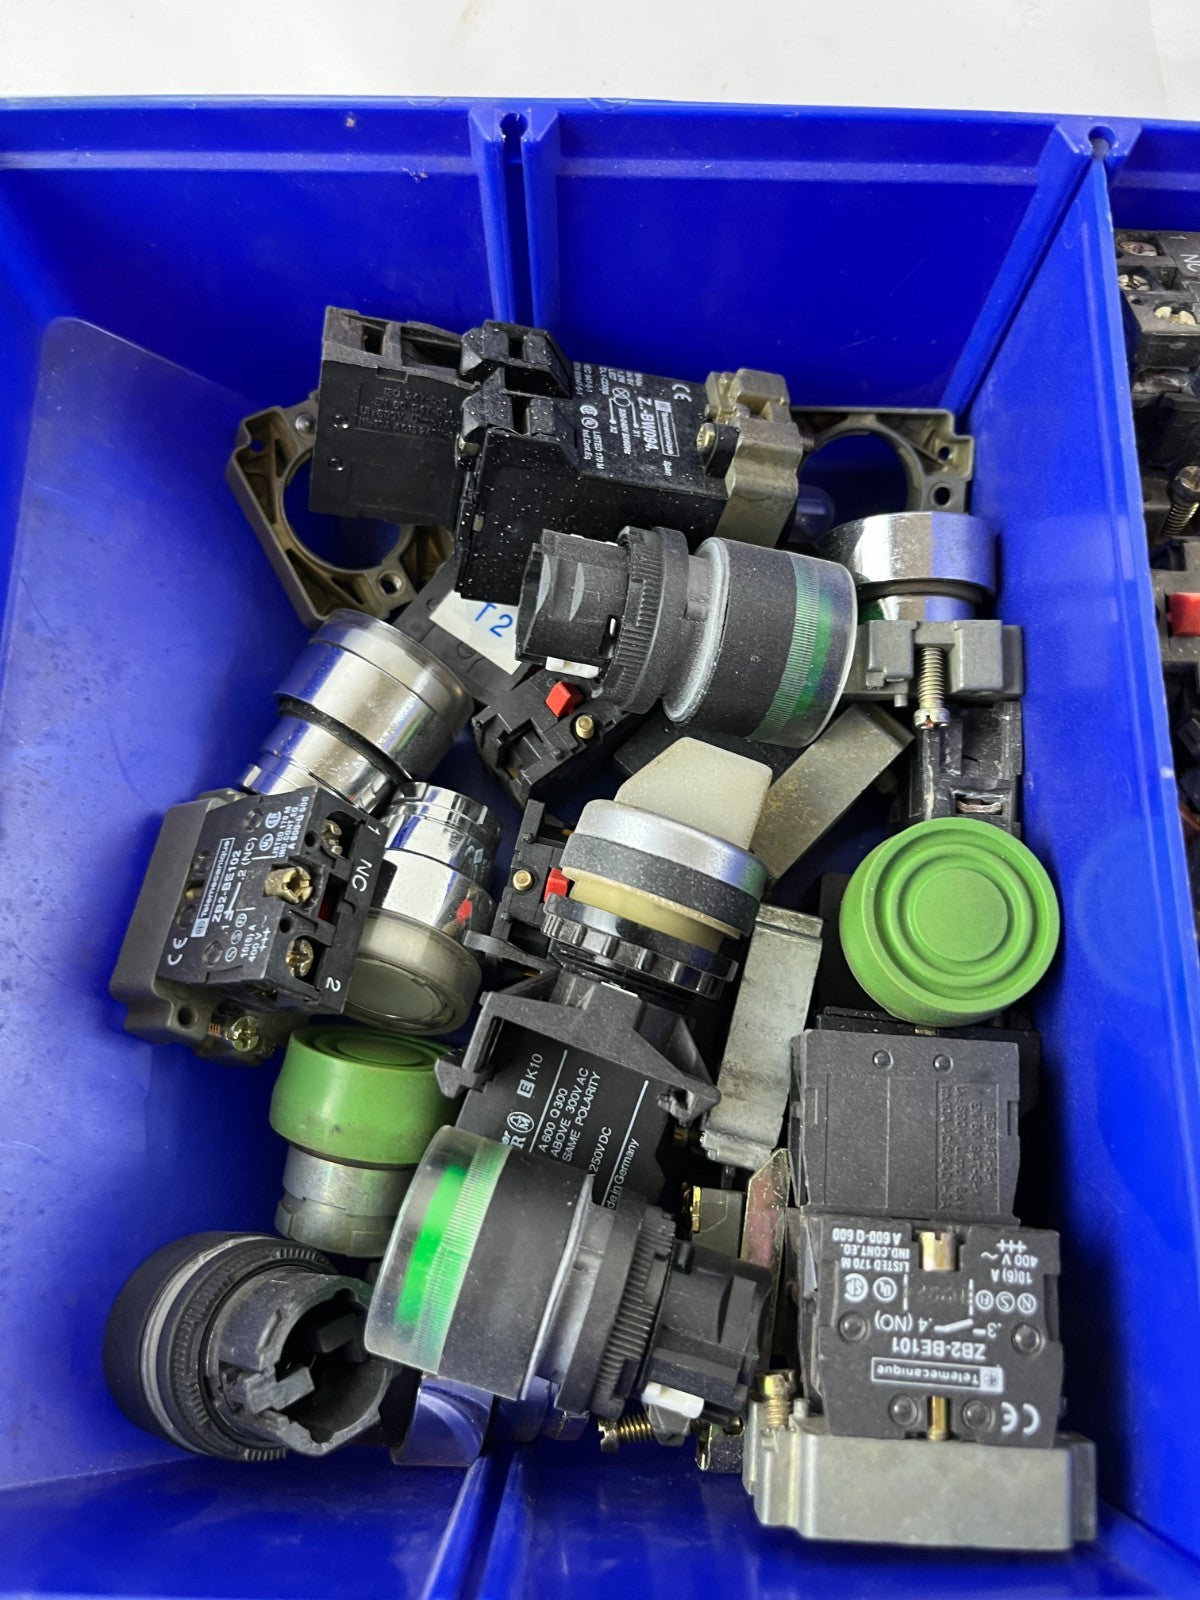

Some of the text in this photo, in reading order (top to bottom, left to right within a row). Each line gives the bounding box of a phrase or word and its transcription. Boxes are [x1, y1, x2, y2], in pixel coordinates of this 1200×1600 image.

[367, 825, 381, 836] 1
[201, 840, 231, 917] Telemecanique
[212, 850, 242, 923] ZB2-BE102
[352, 858, 373, 893] NC
[325, 976, 342, 992] 2
[550, 1067, 590, 1158] ABOVE 300V AC
[562, 1070, 602, 1162] SAME POLARITY
[599, 1126, 613, 1146] DC
[614, 1137, 641, 1185] Germany
[841, 1256, 910, 1272] LISTED 170 M
[1001, 1253, 1039, 1267] 400 V
[991, 1269, 1033, 1285] 10(6) A
[874, 1310, 913, 1332] (NO)
[892, 1337, 987, 1360] ZB2-BE101
[876, 1365, 980, 1387] Telemecanique
